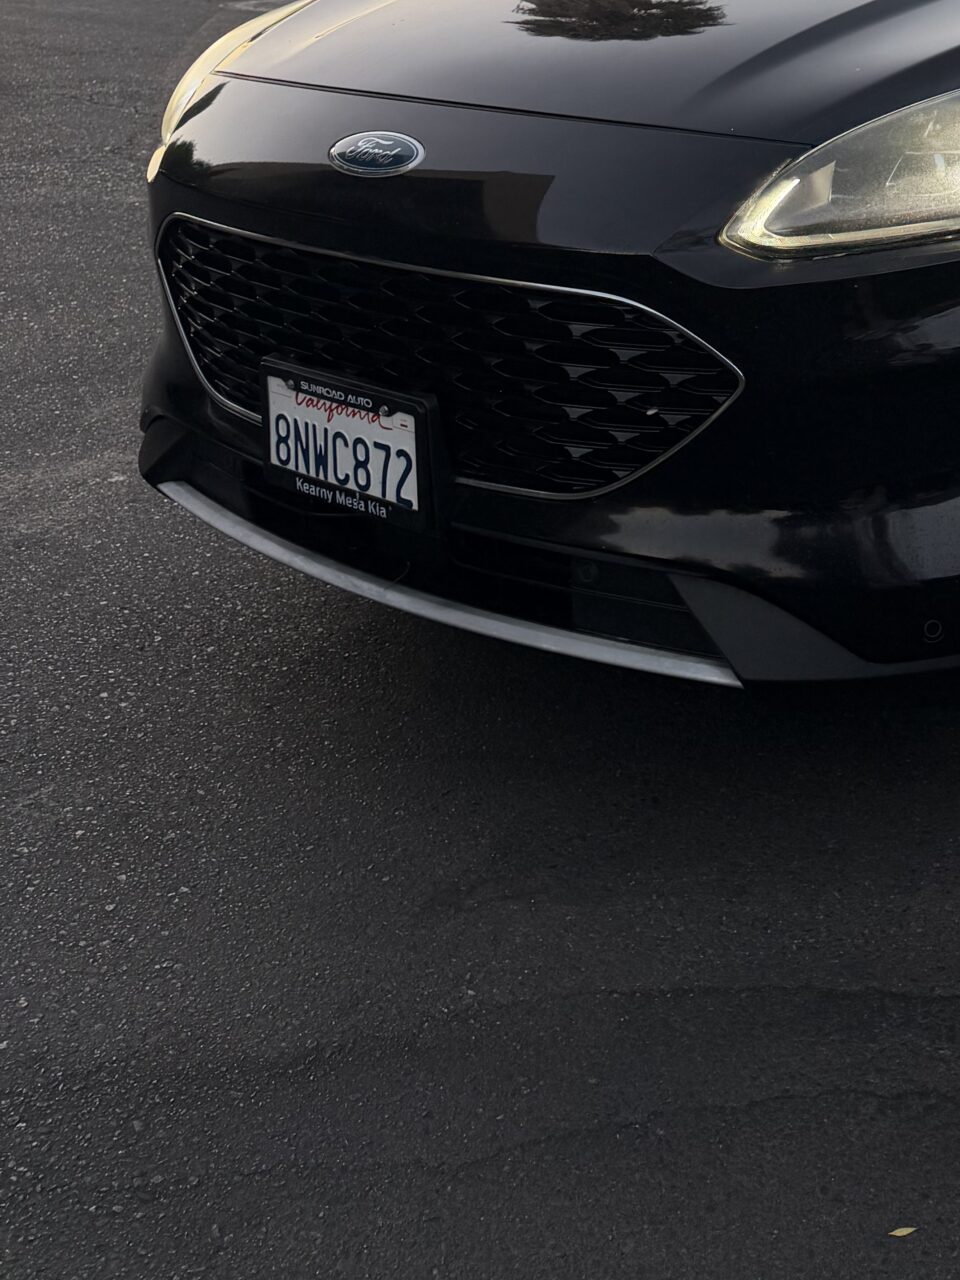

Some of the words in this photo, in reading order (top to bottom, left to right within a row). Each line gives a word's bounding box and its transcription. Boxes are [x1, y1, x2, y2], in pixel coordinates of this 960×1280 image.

[345, 136, 402, 165] Ford
[300, 381, 345, 401] SUNROAD
[347, 394, 373, 408] AUTO
[275, 412, 414, 511] 8NWC872
[296, 477, 333, 503] Kearny
[336, 490, 366, 512] Mesa
[368, 500, 387, 518] Kia
